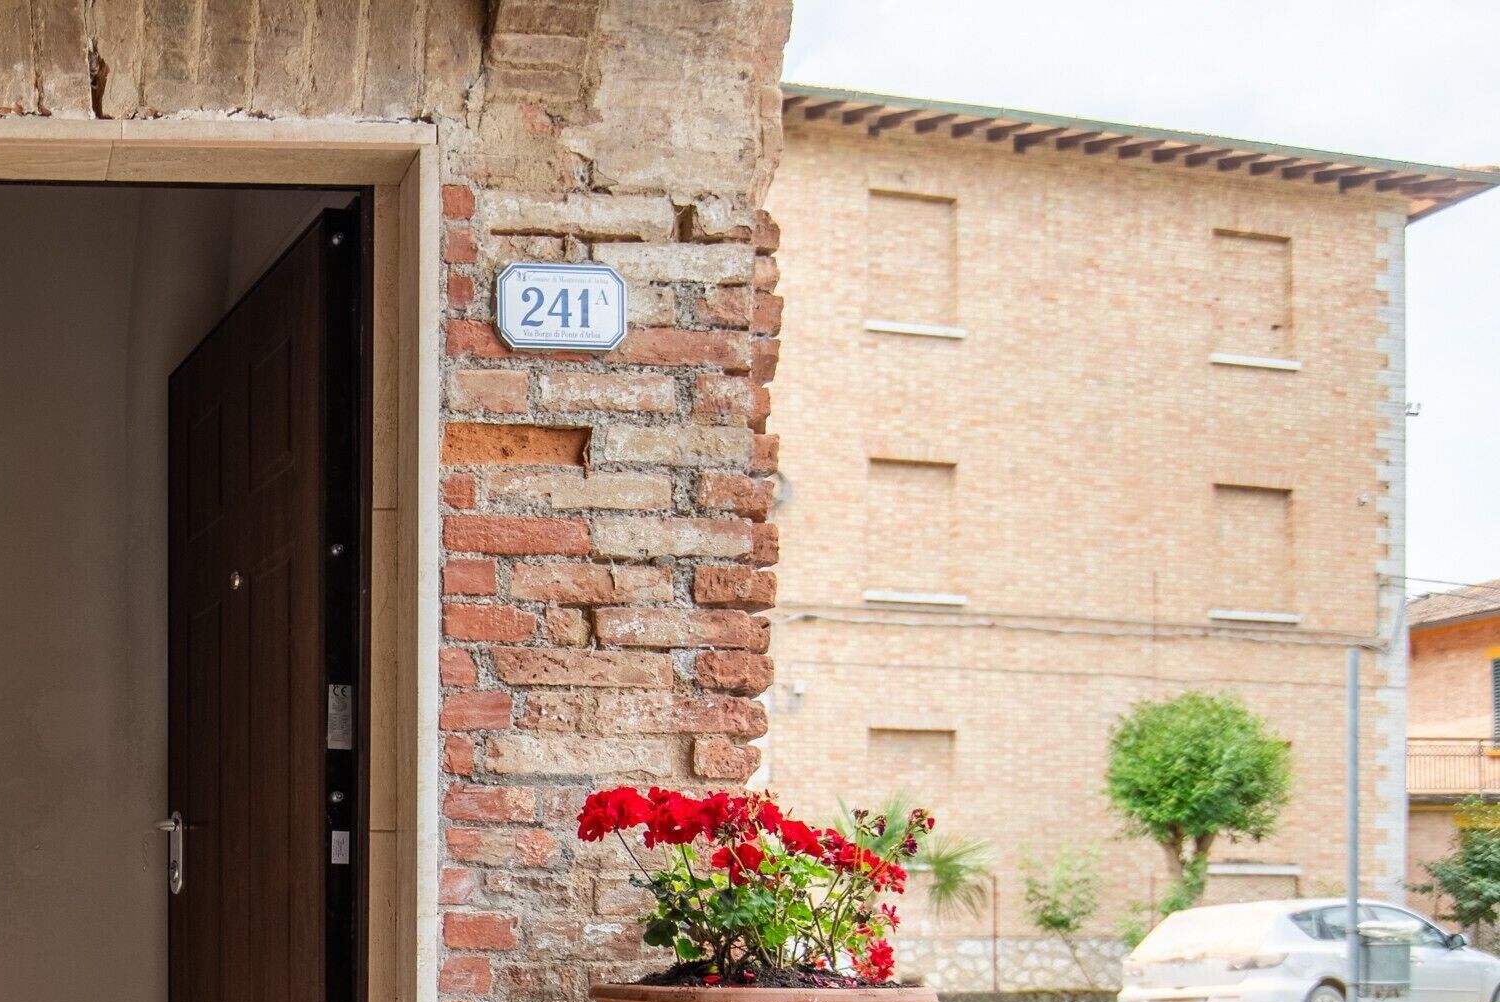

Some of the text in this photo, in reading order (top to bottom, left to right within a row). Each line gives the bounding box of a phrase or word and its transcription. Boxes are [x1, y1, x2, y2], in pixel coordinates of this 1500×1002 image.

[521, 287, 609, 328] 241 A
[523, 329, 533, 337] Via
